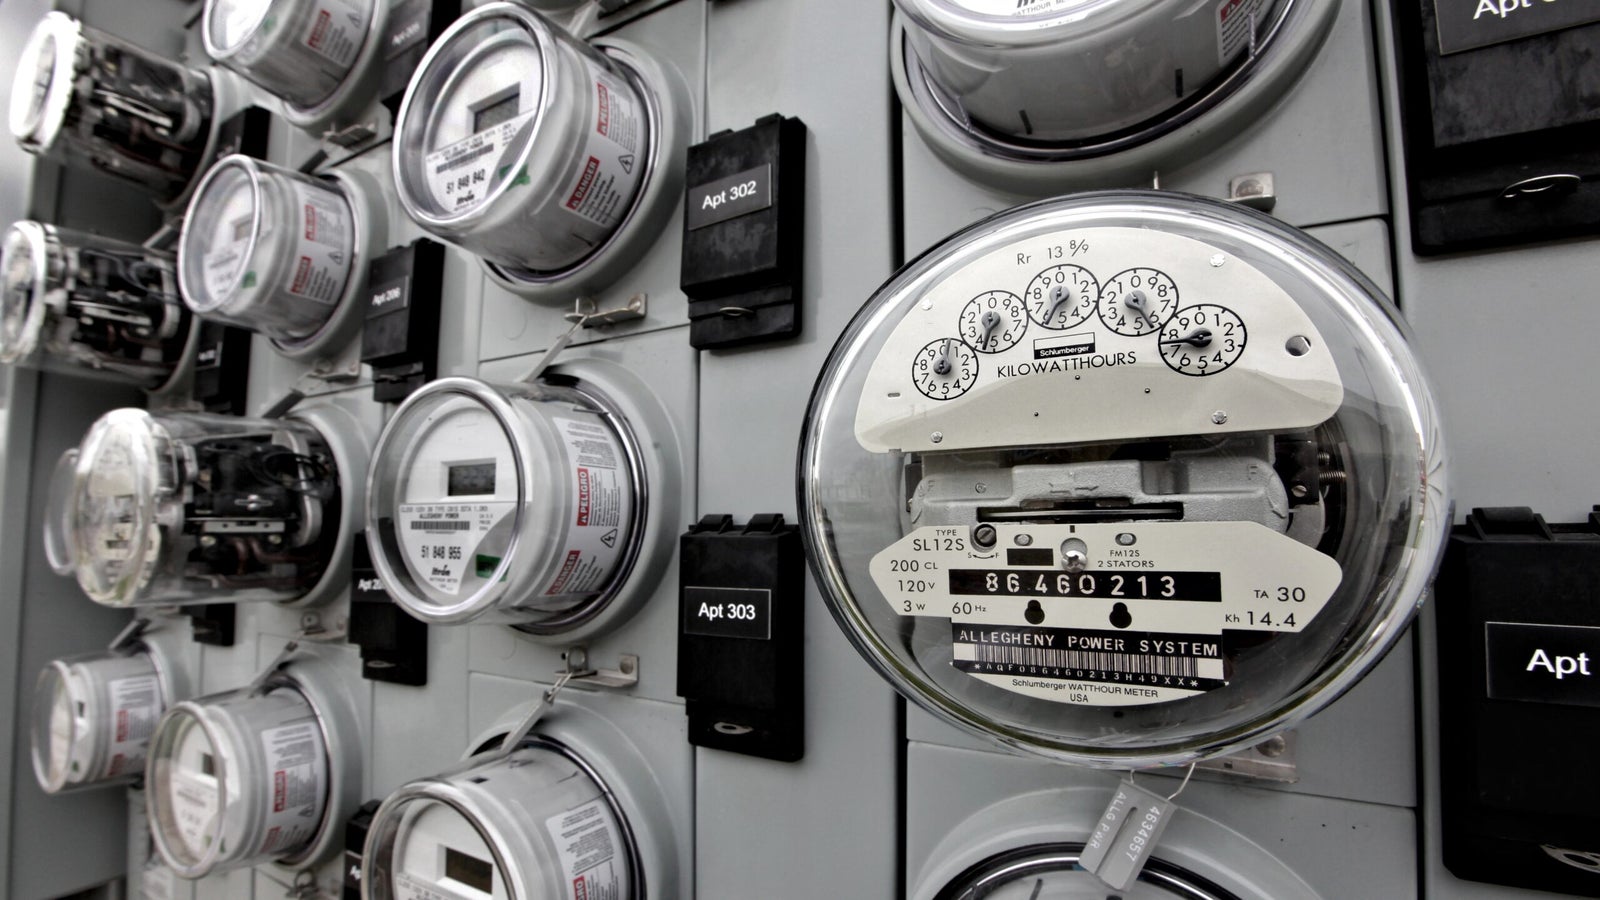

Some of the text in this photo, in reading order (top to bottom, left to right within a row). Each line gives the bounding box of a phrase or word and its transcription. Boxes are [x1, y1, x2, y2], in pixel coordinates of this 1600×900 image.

[575, 161, 597, 200] DANGER
[702, 180, 757, 210] Apt 302
[1017, 252, 1032, 265] Rr
[1048, 245, 1063, 260] 13
[1042, 277, 1051, 289] 9
[1055, 271, 1065, 283] 0
[1072, 272, 1077, 285] 1
[1130, 275, 1141, 288] 0
[1147, 276, 1158, 290] 9
[1080, 280, 1089, 293] 2
[1117, 281, 1123, 294] 1
[1157, 284, 1167, 298] 8
[1033, 287, 1042, 300] 8
[1107, 291, 1117, 304] 2
[1035, 301, 1044, 314] 7
[1081, 295, 1090, 308] 3
[1160, 299, 1171, 313] 7
[1058, 311, 1067, 324] 5
[1071, 305, 1080, 317] 4
[1108, 306, 1118, 320] 3
[968, 297, 1022, 348] 1 0 9 8 7 6 5 4 3 2
[1116, 314, 1126, 326] 4
[1133, 316, 1144, 330] 5
[1179, 317, 1190, 331] 9
[1194, 311, 1206, 326] 0
[1214, 313, 1220, 327] 1
[1223, 322, 1234, 336] 2
[954, 346, 959, 358] 1
[1039, 345, 1090, 357] Schlumberger
[1170, 344, 1181, 358] 7
[1224, 338, 1235, 353] 3
[927, 349, 936, 361] 9
[961, 354, 970, 366] 2
[1180, 353, 1191, 367] 6
[1212, 350, 1223, 363] 4
[920, 359, 928, 371] 8
[997, 351, 1137, 378] KILOWATTHOURS
[1197, 355, 1208, 370] 5
[921, 373, 929, 384] 7
[961, 368, 970, 381] 3
[928, 380, 937, 392] 6
[941, 382, 950, 394] 5
[952, 378, 961, 389] 4
[580, 471, 589, 514] PELIGRO
[936, 529, 957, 537] TYPE
[913, 538, 965, 551] SL12S
[1109, 550, 1140, 558] FM12S
[890, 559, 938, 572] 200 CL
[1098, 560, 1155, 568] 2 STATORS
[1253, 586, 1306, 602] TA 30
[698, 602, 756, 621] Apt 303
[903, 600, 912, 612] 3
[952, 602, 972, 615] 60
[1225, 611, 1296, 627] Kh 14.4
[959, 630, 1218, 657] ALLEGHENY POWER SYSTEM
[1526, 648, 1591, 680] Apt
[1012, 678, 1159, 698] Schlumberger WATTHOUR METER
[1070, 693, 1089, 703] USA
[1089, 791, 1127, 849] ALLG PWR
[1125, 806, 1161, 862] 4634657
